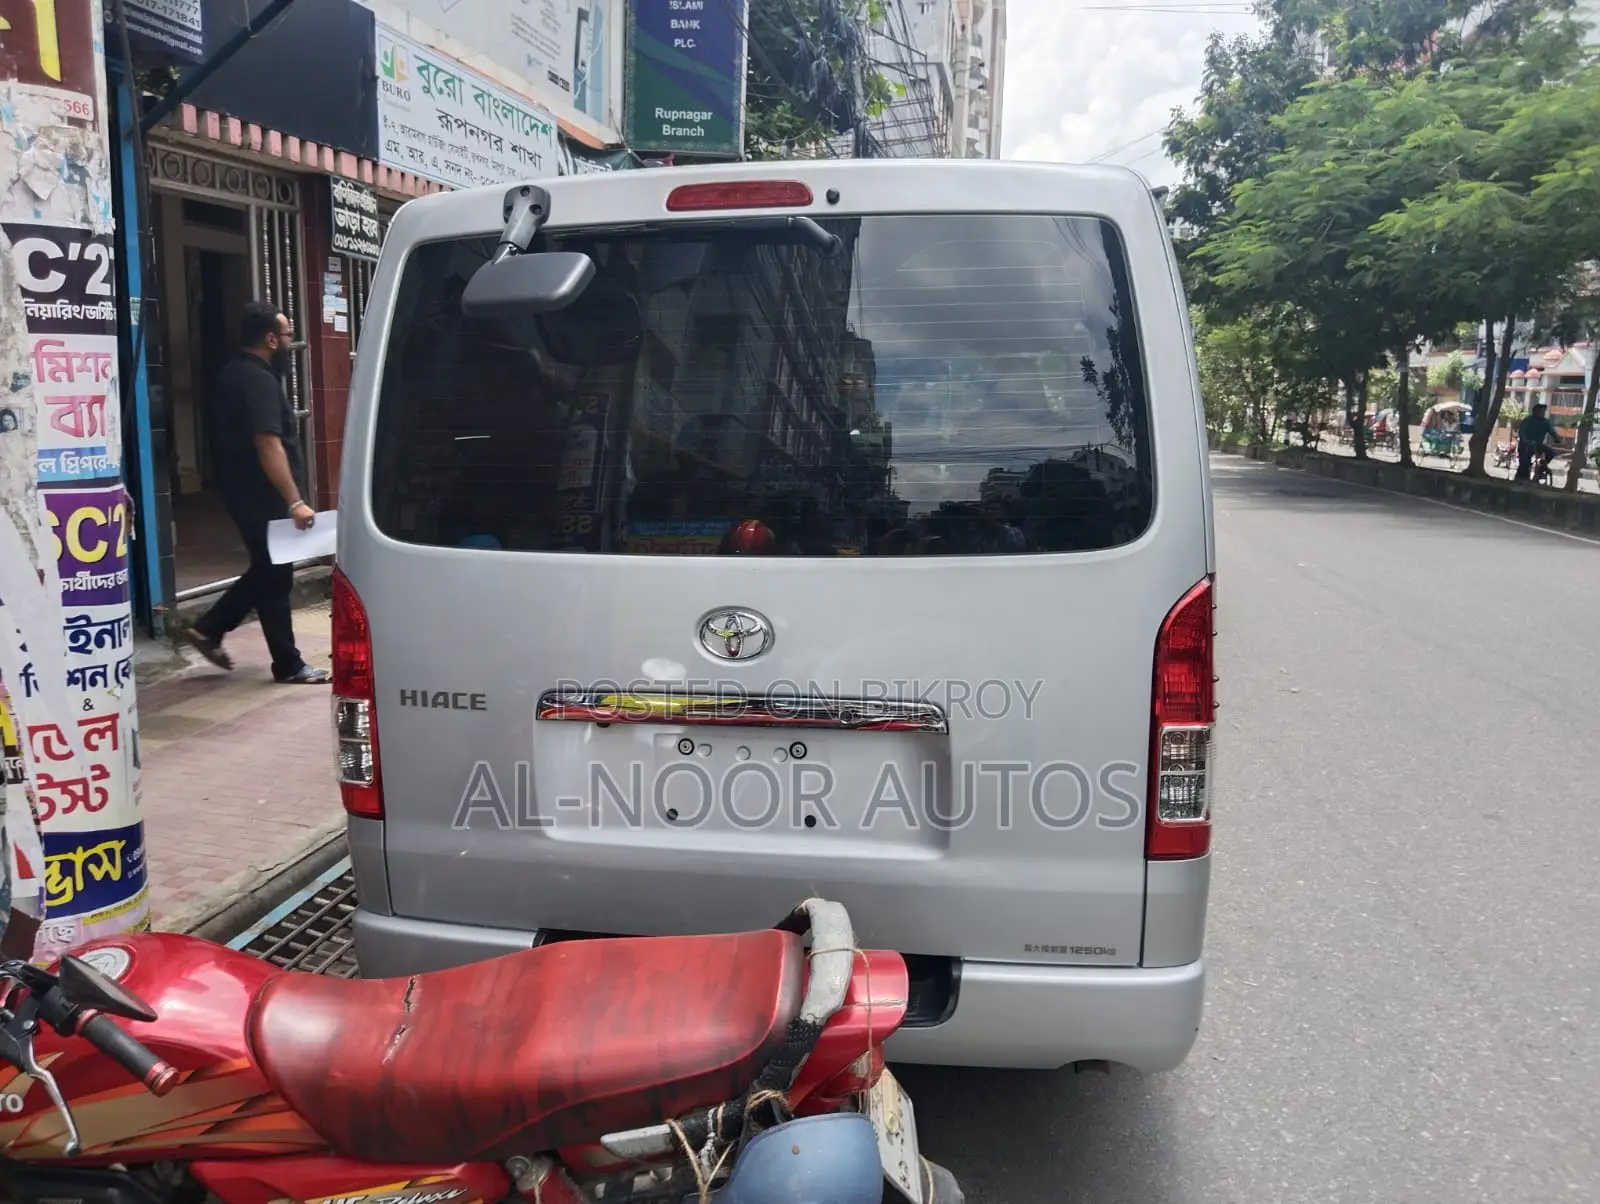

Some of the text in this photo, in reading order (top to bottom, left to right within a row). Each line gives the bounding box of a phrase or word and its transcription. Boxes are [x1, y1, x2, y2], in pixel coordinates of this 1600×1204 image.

[670, 19, 701, 29] BANK
[414, 54, 465, 106] বুরো
[471, 84, 553, 148] বাংলাদেশ
[655, 107, 713, 122] Rupnagar
[662, 124, 705, 137] Branch
[435, 108, 504, 154] রূপনগর
[509, 141, 544, 171] শাখা
[82, 698, 95, 711] &
[400, 688, 487, 711] HIACE
[1070, 945, 1116, 956] 1250kg
